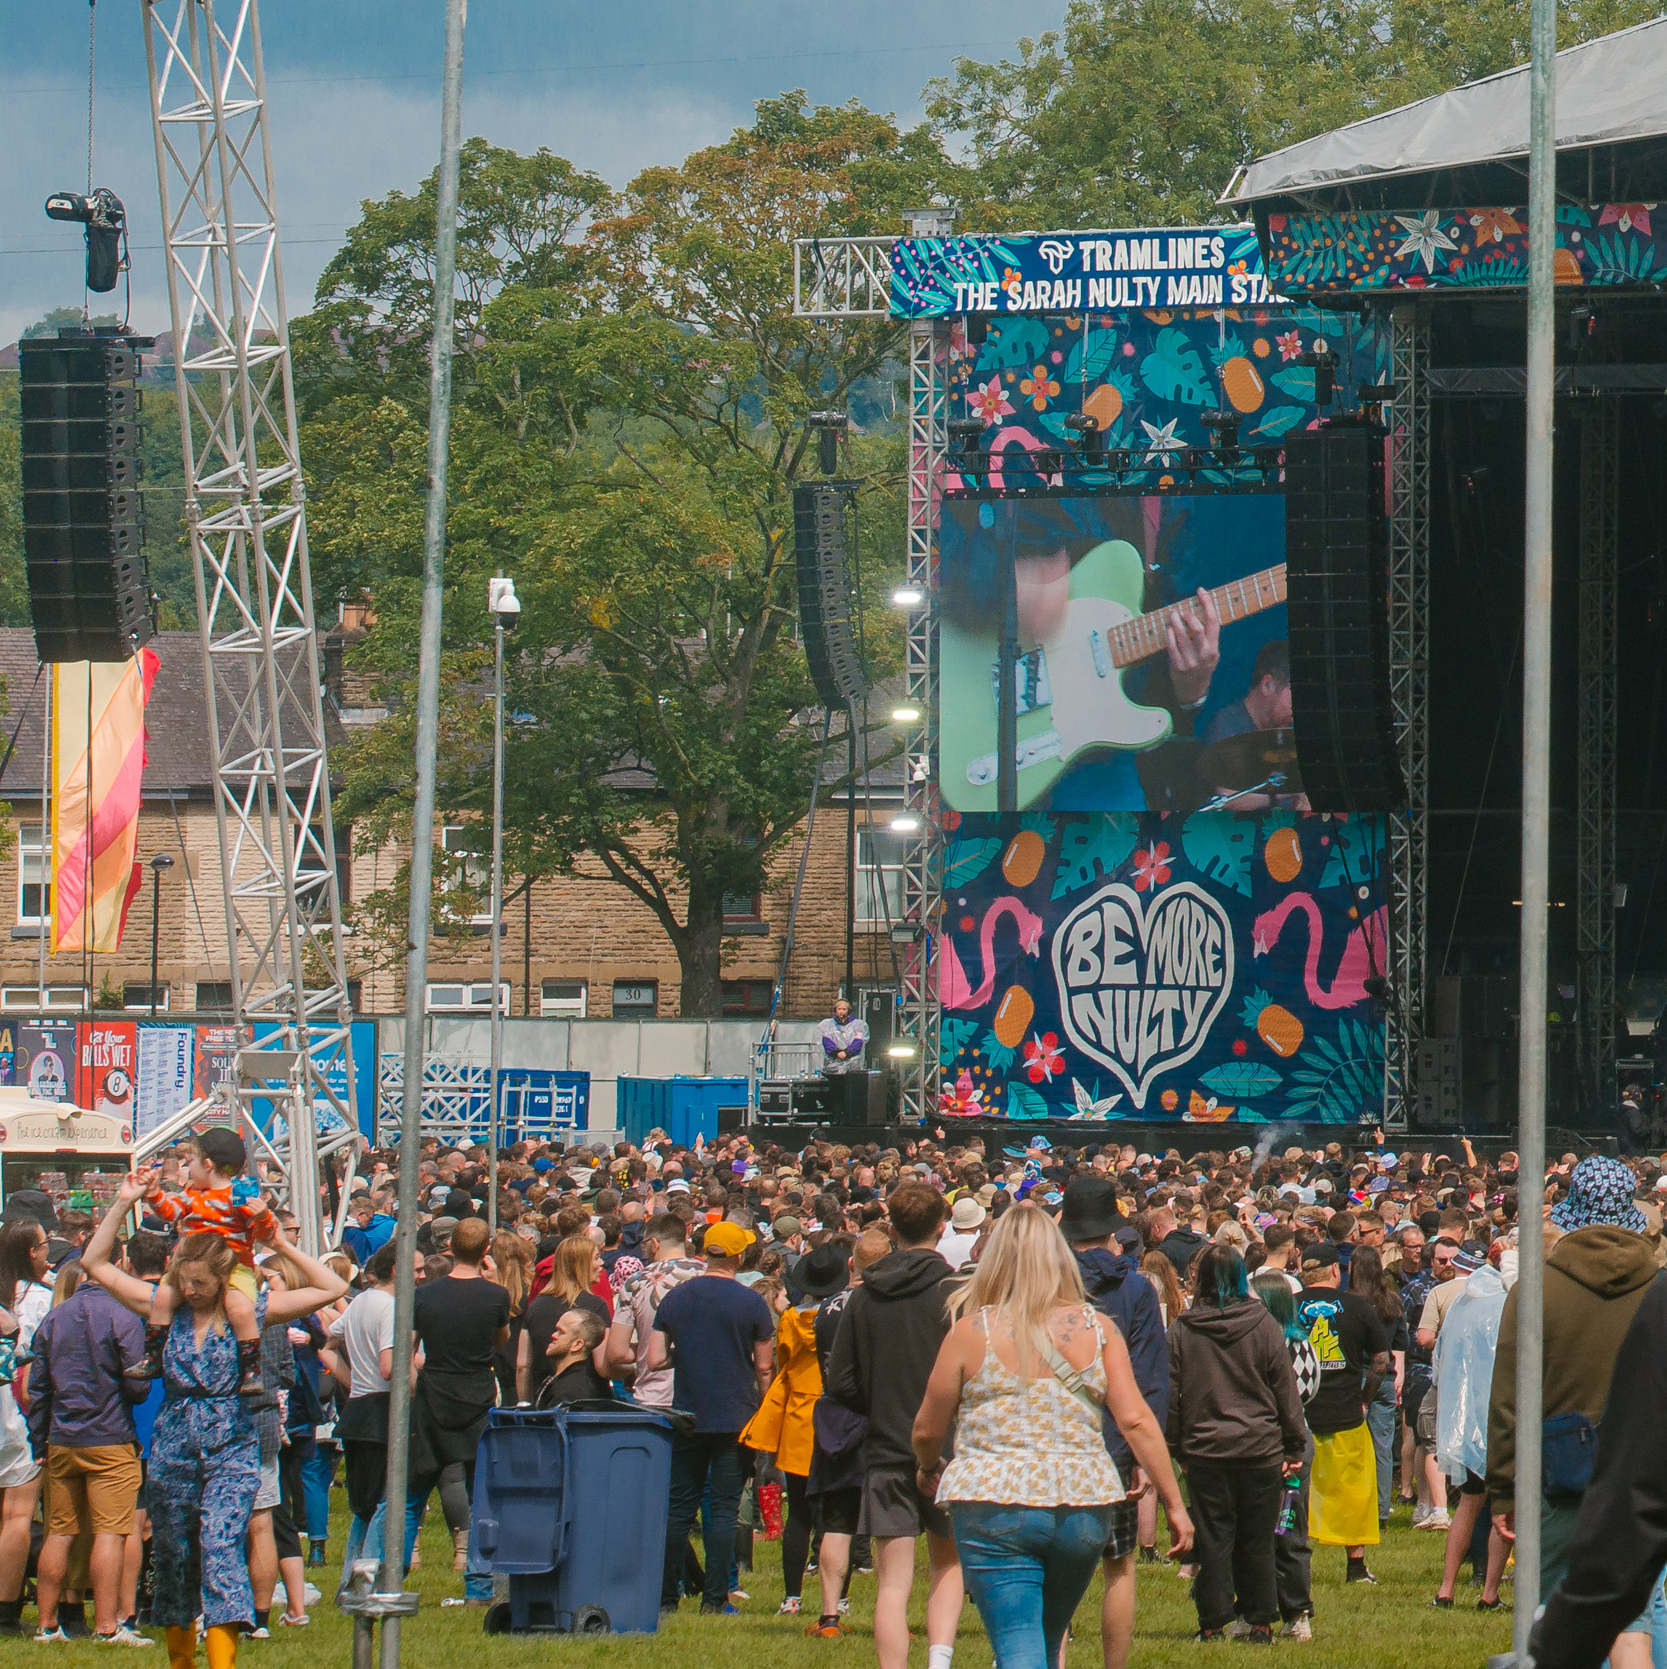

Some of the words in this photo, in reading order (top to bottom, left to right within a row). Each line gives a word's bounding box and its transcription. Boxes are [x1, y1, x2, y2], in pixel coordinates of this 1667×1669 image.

[1079, 236, 1225, 271] TRAMLINES
[954, 282, 998, 311] THE
[1007, 279, 1081, 311] SARAH
[1088, 276, 1161, 309] NULTY
[1167, 275, 1222, 305] MAIN
[1232, 273, 1295, 304] STA
[1066, 902, 1138, 987] BE
[1146, 897, 1222, 986] MORE
[625, 988, 641, 1000] 30
[105, 1030, 126, 1046] Your
[1071, 989, 1212, 1077] NULTY
[112, 1045, 132, 1067] WET
[174, 1032, 188, 1092] Foundry.
[113, 1076, 121, 1092] 8
